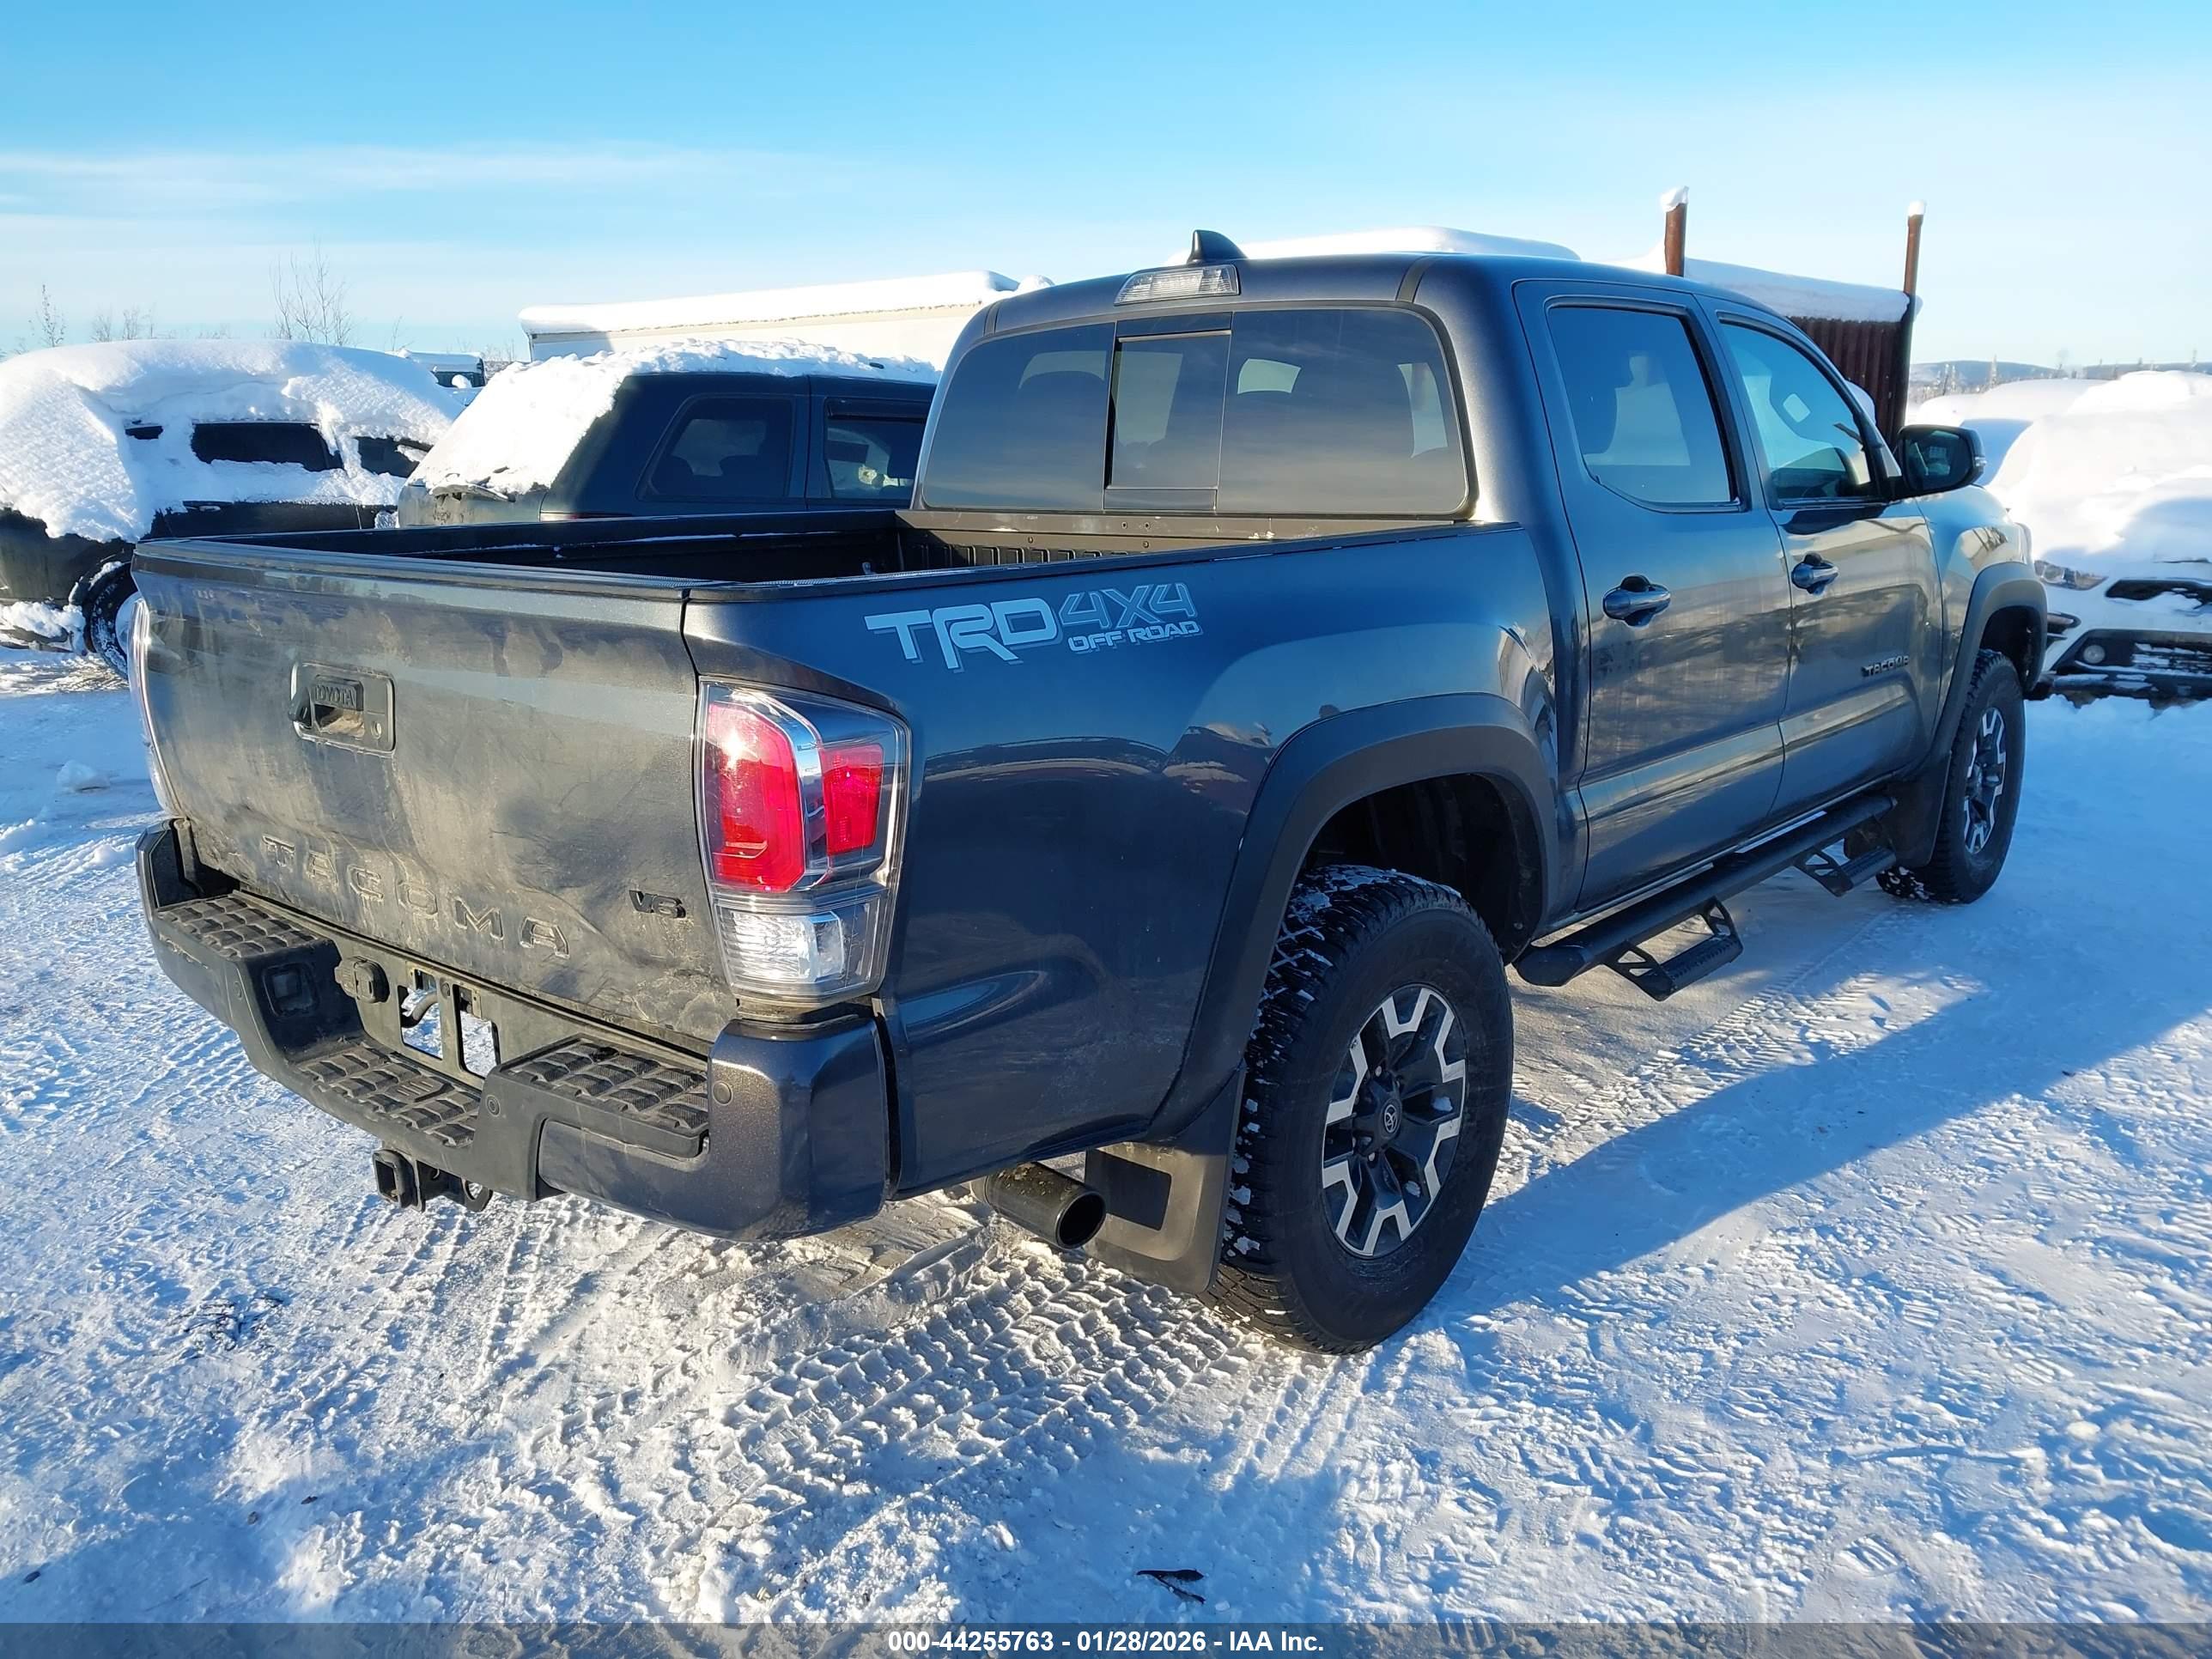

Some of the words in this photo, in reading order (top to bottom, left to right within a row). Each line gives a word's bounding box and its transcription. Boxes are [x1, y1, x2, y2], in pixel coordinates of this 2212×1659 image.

[864, 598, 1061, 672] TRD
[1058, 582, 1199, 630] 4X4
[1067, 629, 1124, 653] OFF
[1127, 620, 1201, 644] ROAD
[313, 684, 357, 708] TOYOTA
[262, 836, 570, 959] TACOMA
[629, 890, 687, 919] V6
